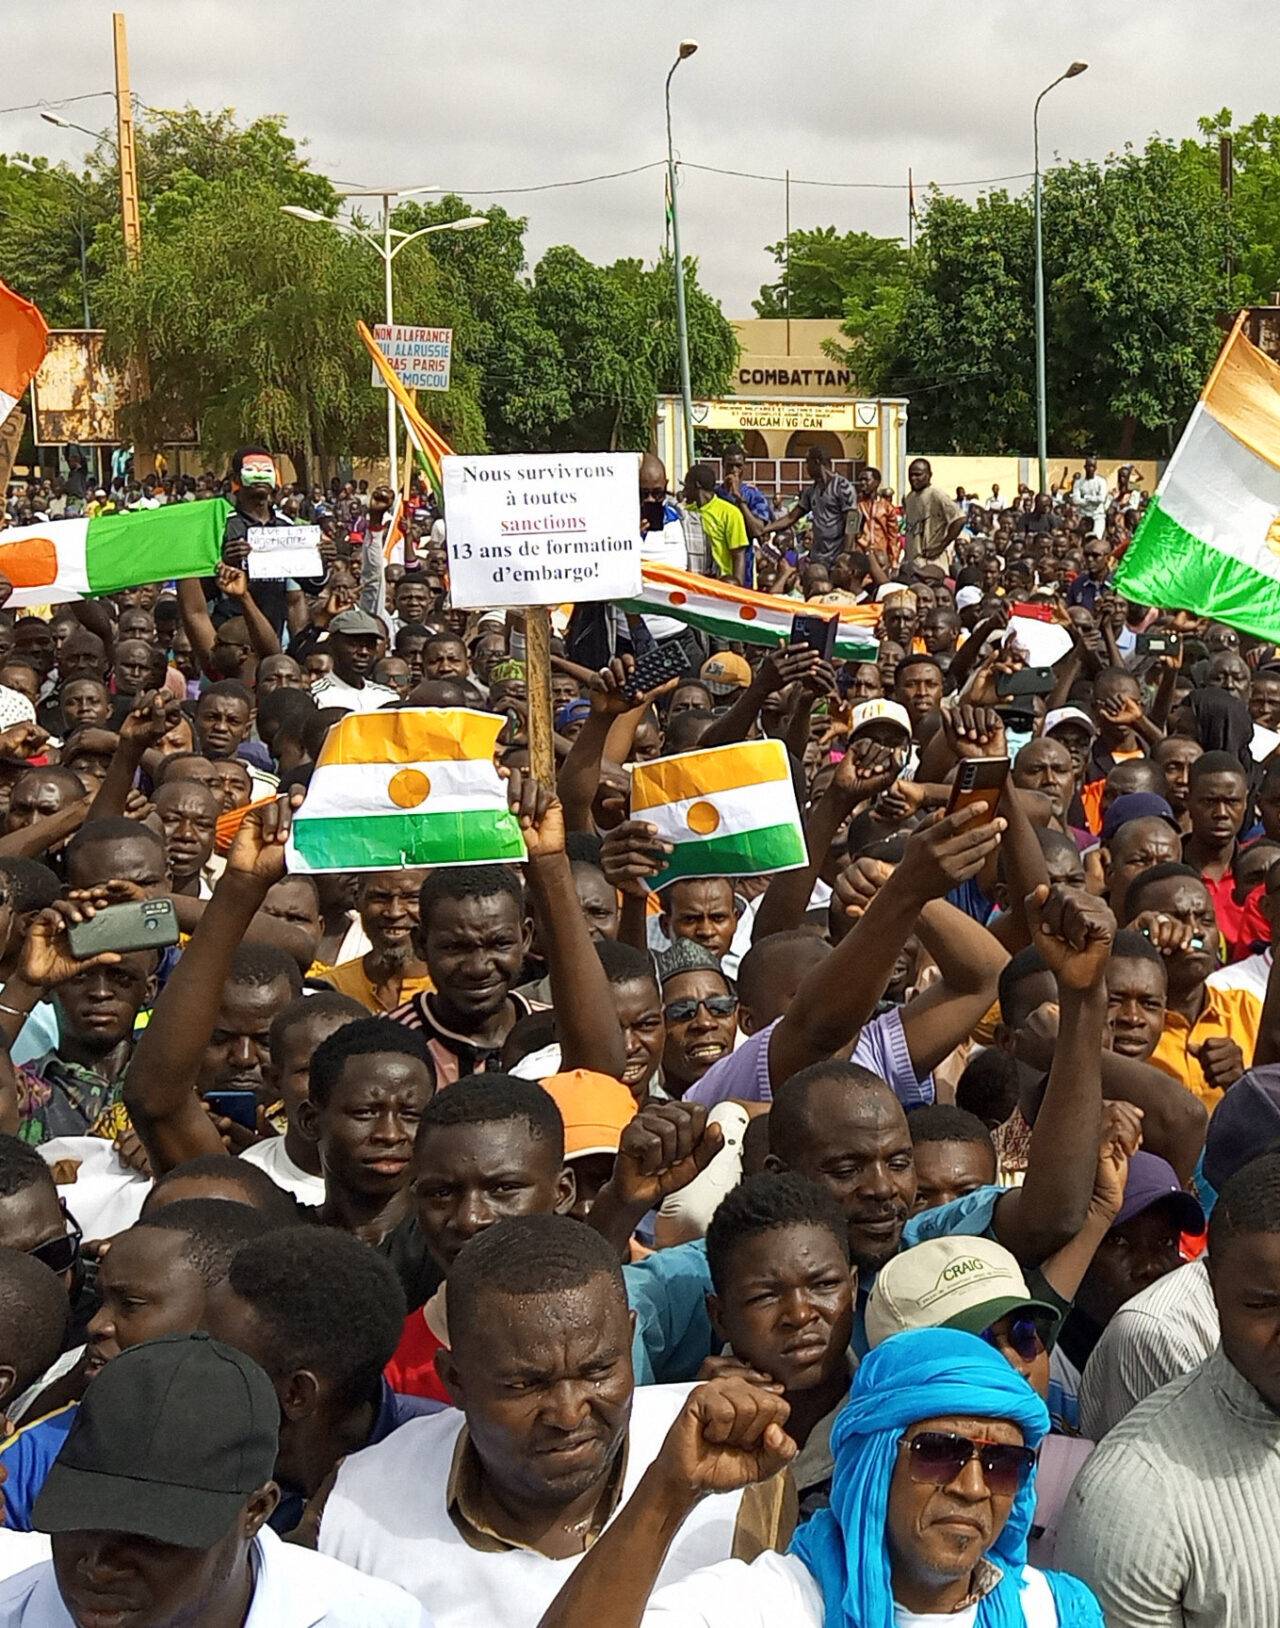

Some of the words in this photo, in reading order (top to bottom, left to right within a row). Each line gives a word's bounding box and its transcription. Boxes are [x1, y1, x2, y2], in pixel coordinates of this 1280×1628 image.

[374, 328, 392, 341] NON
[413, 359, 445, 372] PARIS
[403, 373, 447, 388] MOSCOU
[462, 466, 512, 483] Nous
[517, 463, 614, 481] survivrons
[506, 490, 516, 506] à
[523, 490, 578, 506] toutes
[501, 514, 587, 532] sanctions
[452, 543, 472, 560] 13
[480, 545, 512, 559] ans
[518, 541, 540, 556] de
[546, 537, 633, 555] formation
[492, 562, 600, 583] d'embargo!
[943, 1258, 984, 1281] CRAIG
